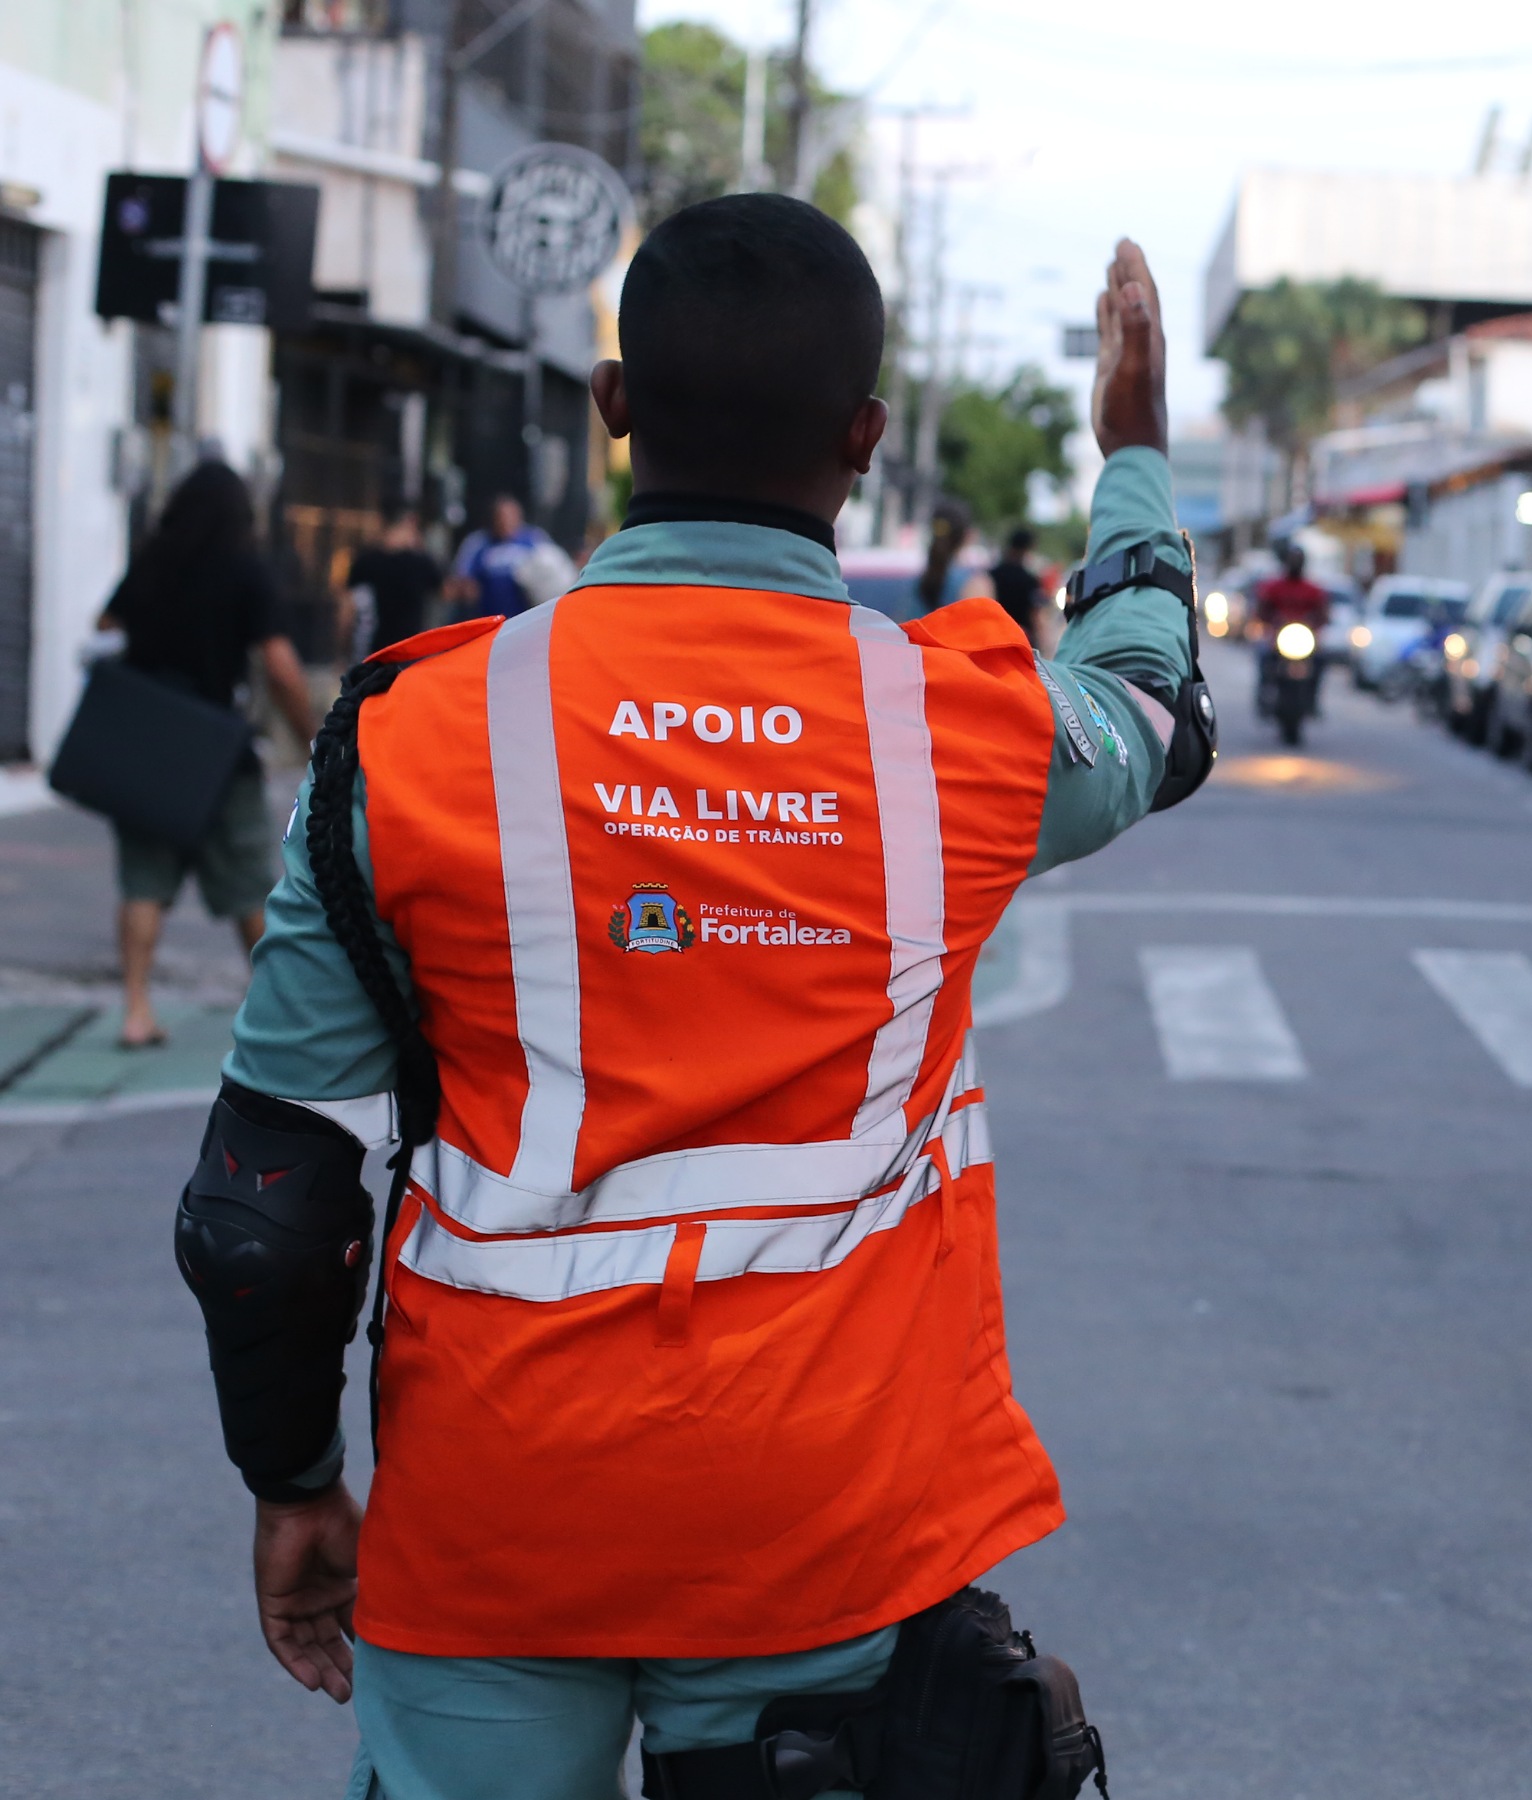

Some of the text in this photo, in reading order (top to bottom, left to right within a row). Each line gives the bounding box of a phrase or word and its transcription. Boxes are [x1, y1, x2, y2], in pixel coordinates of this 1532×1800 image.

[608, 700, 803, 744] APOIO
[593, 782, 839, 823] VIA LIVRE
[604, 822, 843, 846] OPERAÇÃO DE TRÂNSITO
[700, 903, 796, 919] Prefeitura de
[701, 917, 851, 945] Fortaleza
